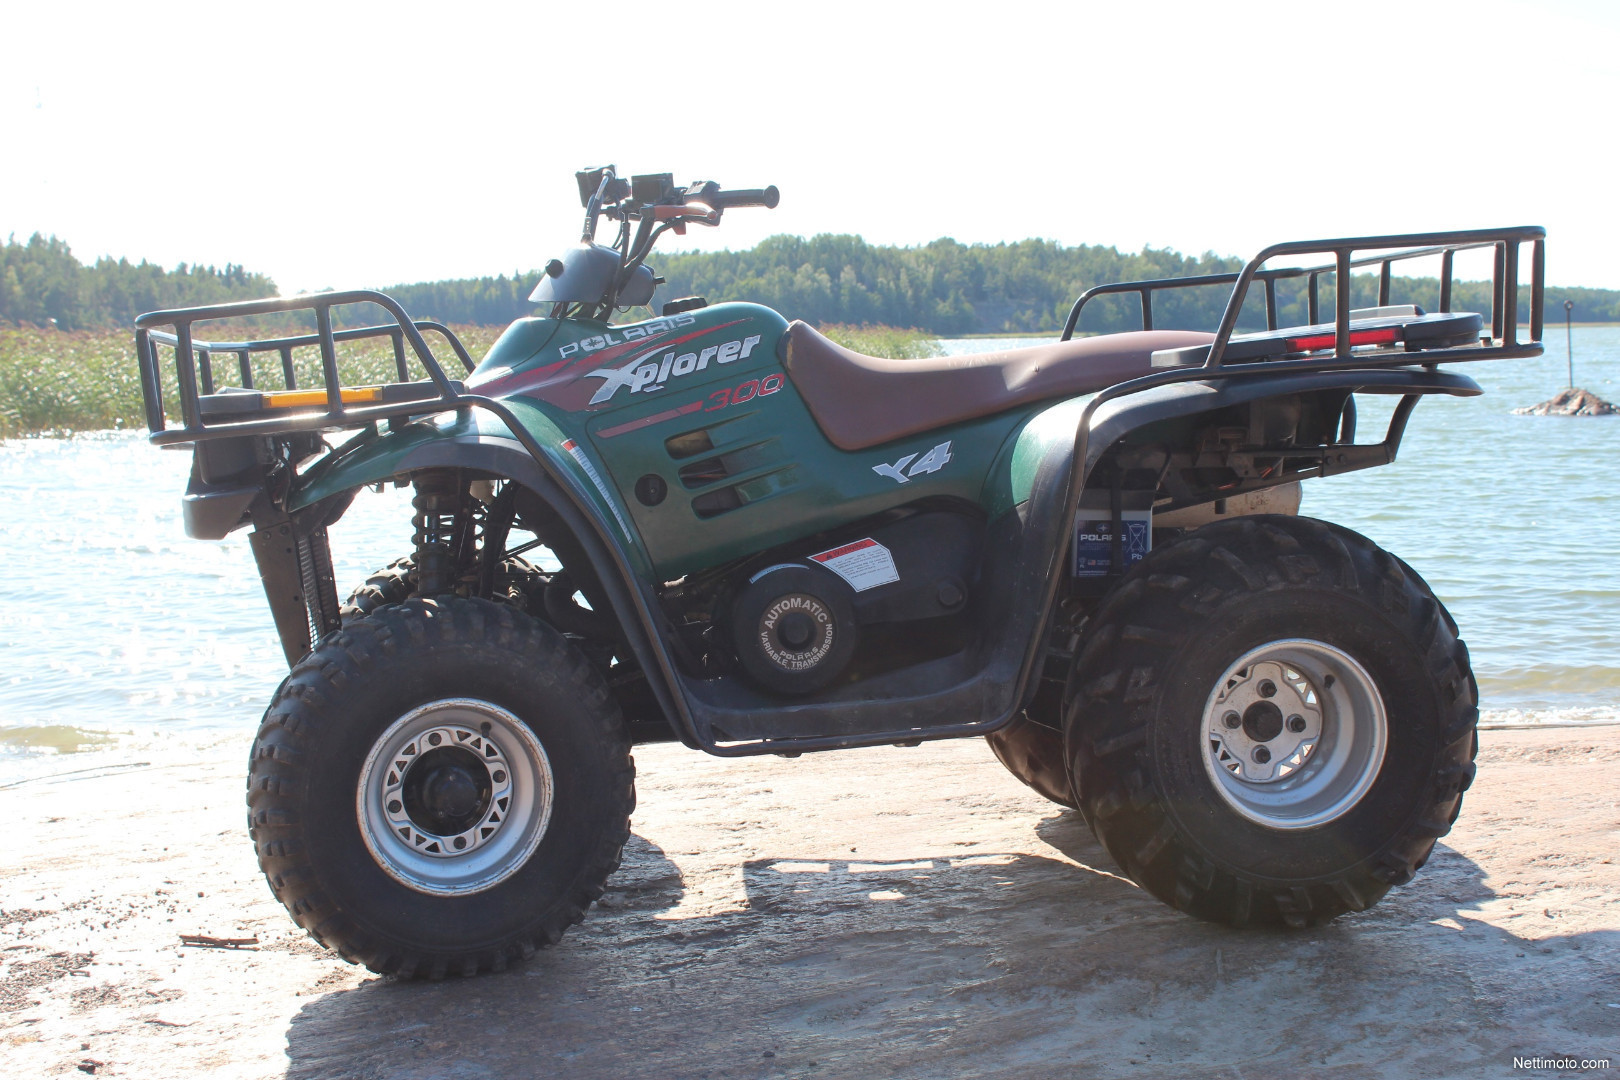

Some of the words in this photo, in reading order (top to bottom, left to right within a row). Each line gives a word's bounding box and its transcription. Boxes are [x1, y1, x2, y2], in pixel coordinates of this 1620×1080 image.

[558, 313, 696, 359] POLARIS
[584, 334, 761, 405] Xplorer
[704, 373, 785, 412] 300
[764, 598, 828, 629] AUTOMATIC
[760, 631, 788, 667] VARIABLE
[791, 623, 833, 669] TRANSMISSION
[779, 647, 819, 661] POLARIS
